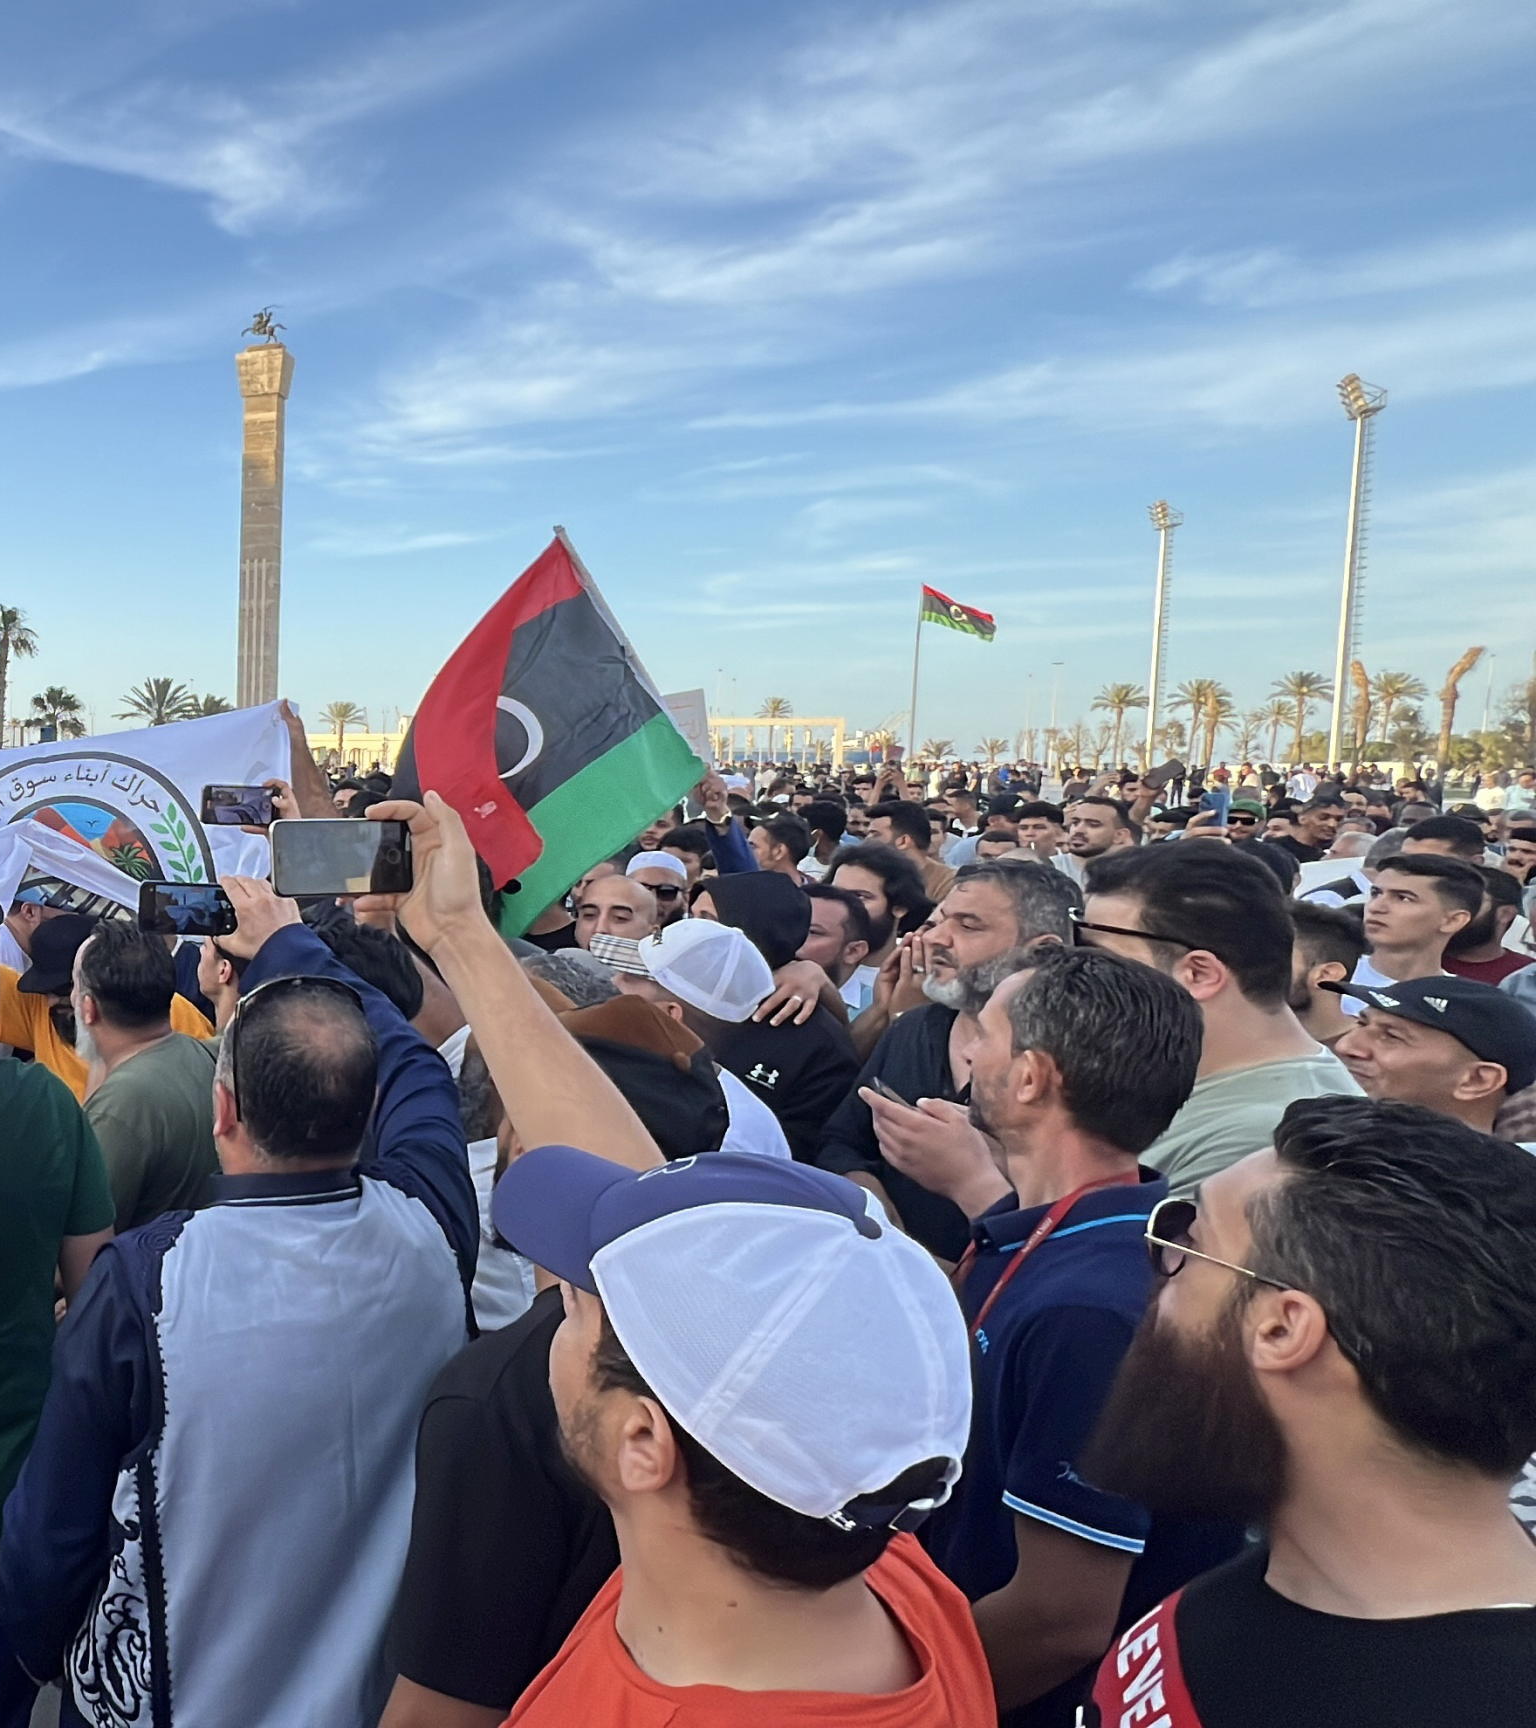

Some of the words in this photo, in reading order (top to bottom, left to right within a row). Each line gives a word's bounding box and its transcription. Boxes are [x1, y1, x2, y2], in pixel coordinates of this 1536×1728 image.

[9, 775, 57, 802] سوق
[64, 763, 112, 787] أبناء
[110, 773, 160, 813] حراك
